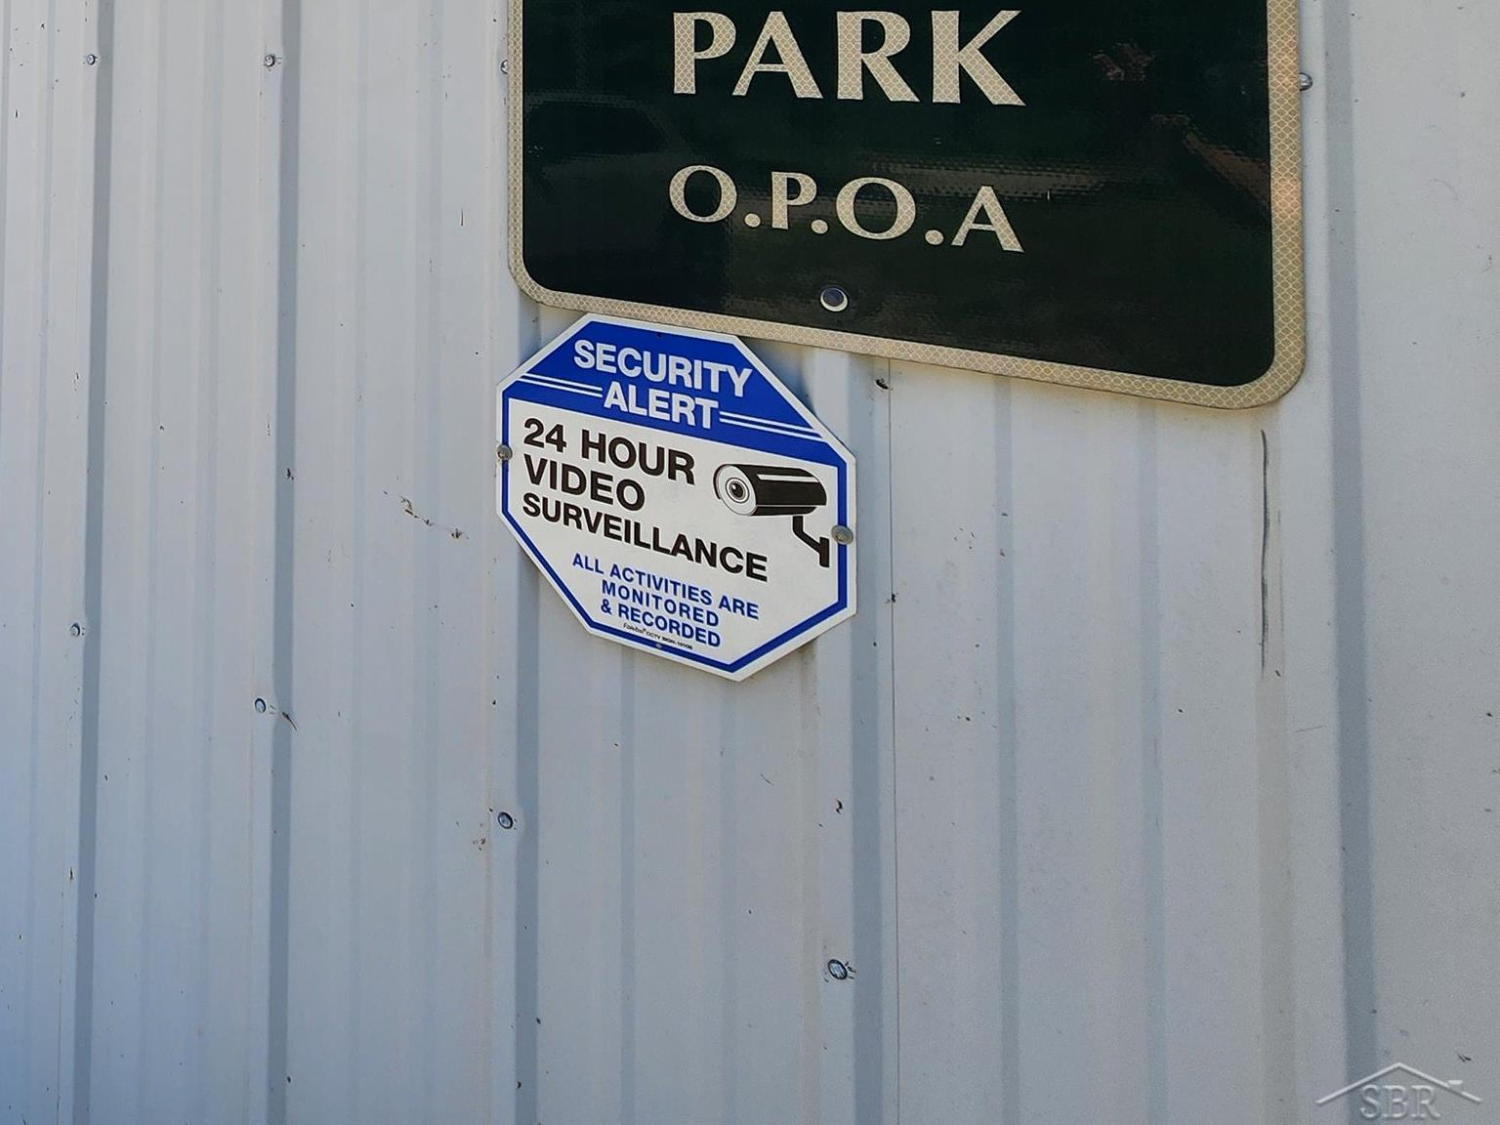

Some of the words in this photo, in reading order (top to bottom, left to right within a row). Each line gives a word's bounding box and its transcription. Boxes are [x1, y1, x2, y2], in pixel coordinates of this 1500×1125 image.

[671, 9, 1027, 107] PARK
[668, 163, 1025, 253] O.P.O.A
[573, 339, 753, 398] SECURITY
[603, 381, 719, 429] ALERT
[523, 418, 567, 453] 24
[581, 428, 696, 485] HOUR
[523, 453, 645, 512] VIDEO
[522, 492, 768, 582] SURVEILLANCE
[572, 552, 605, 575] ALL
[609, 563, 713, 606] ACTIVITIES
[718, 595, 760, 620] ARE
[602, 579, 720, 627] MONITORED
[600, 599, 613, 616] &
[618, 605, 721, 648] RECORDED
